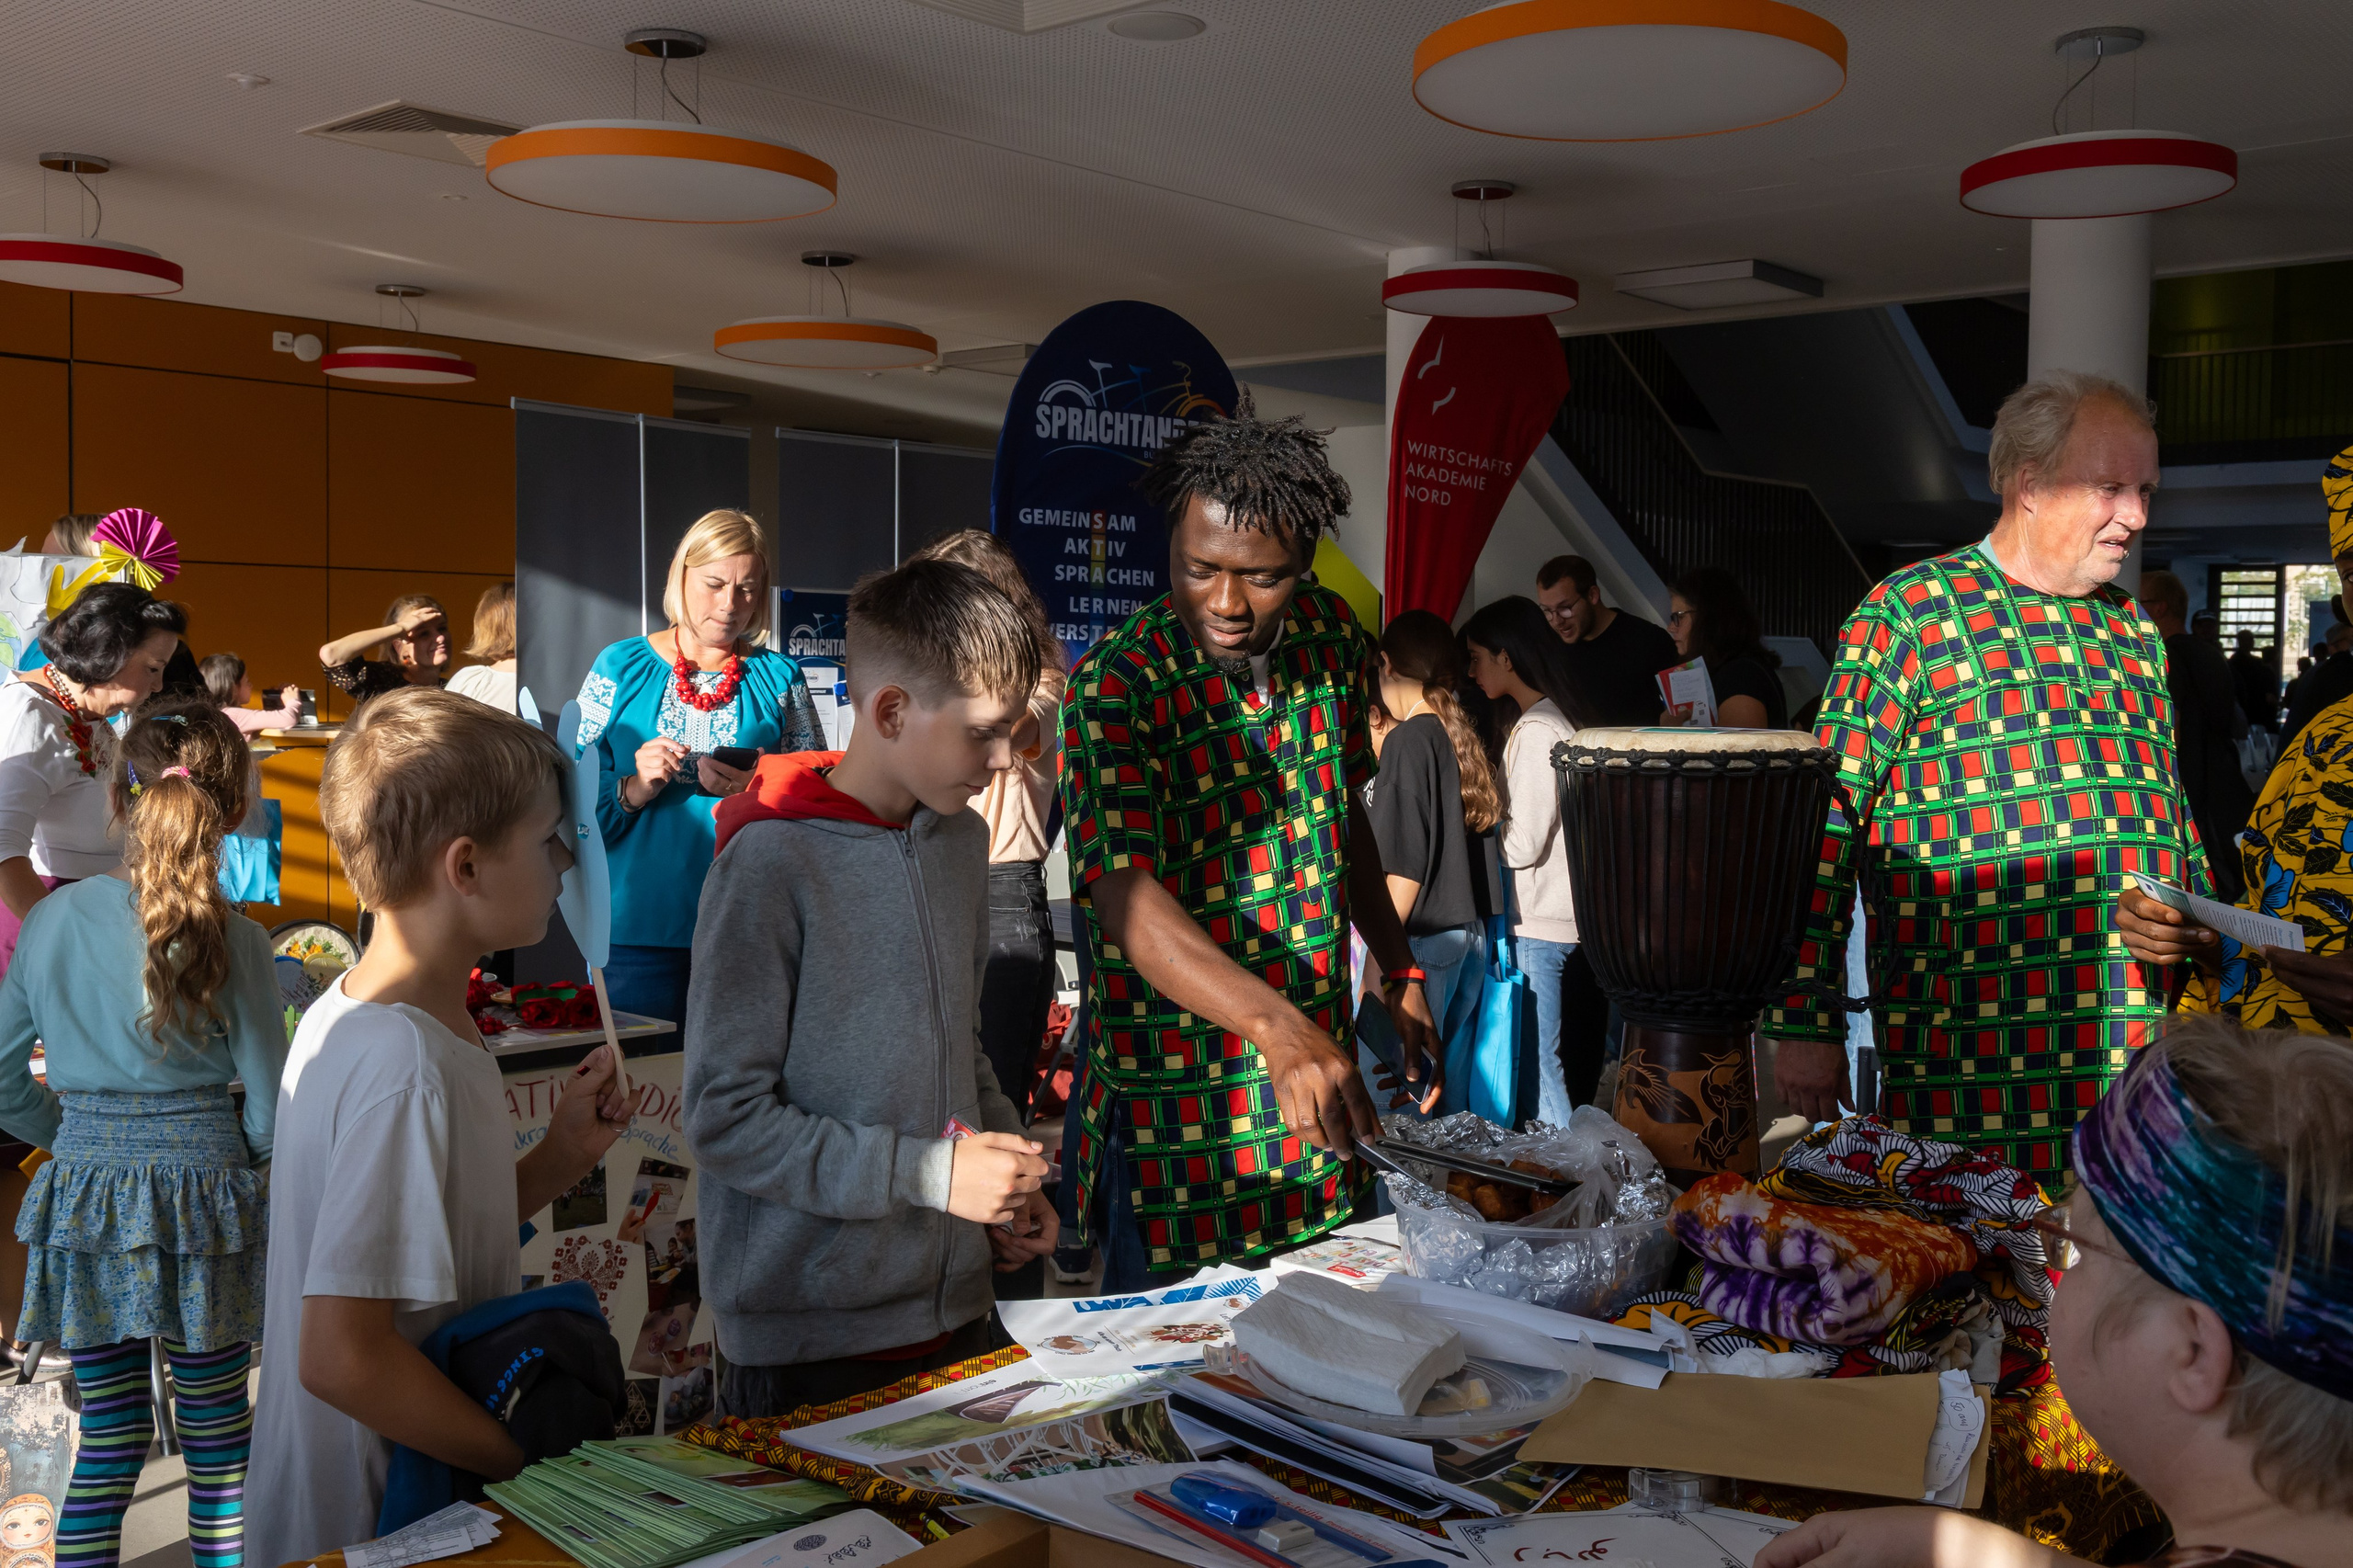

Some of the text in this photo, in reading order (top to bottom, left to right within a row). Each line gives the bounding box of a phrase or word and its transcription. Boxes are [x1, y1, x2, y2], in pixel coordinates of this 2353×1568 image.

[1036, 404, 1199, 449] SPRACHTAND
[1407, 439, 1513, 476] WIRTSCHAFTS
[1404, 461, 1487, 491] AKADEMIE
[1404, 483, 1451, 506] NORD
[1018, 507, 1137, 532] GEMEINSAM
[1063, 538, 1127, 557] AKTIV
[1054, 564, 1154, 587] SPRACHEN
[1069, 596, 1142, 616] LERNEN
